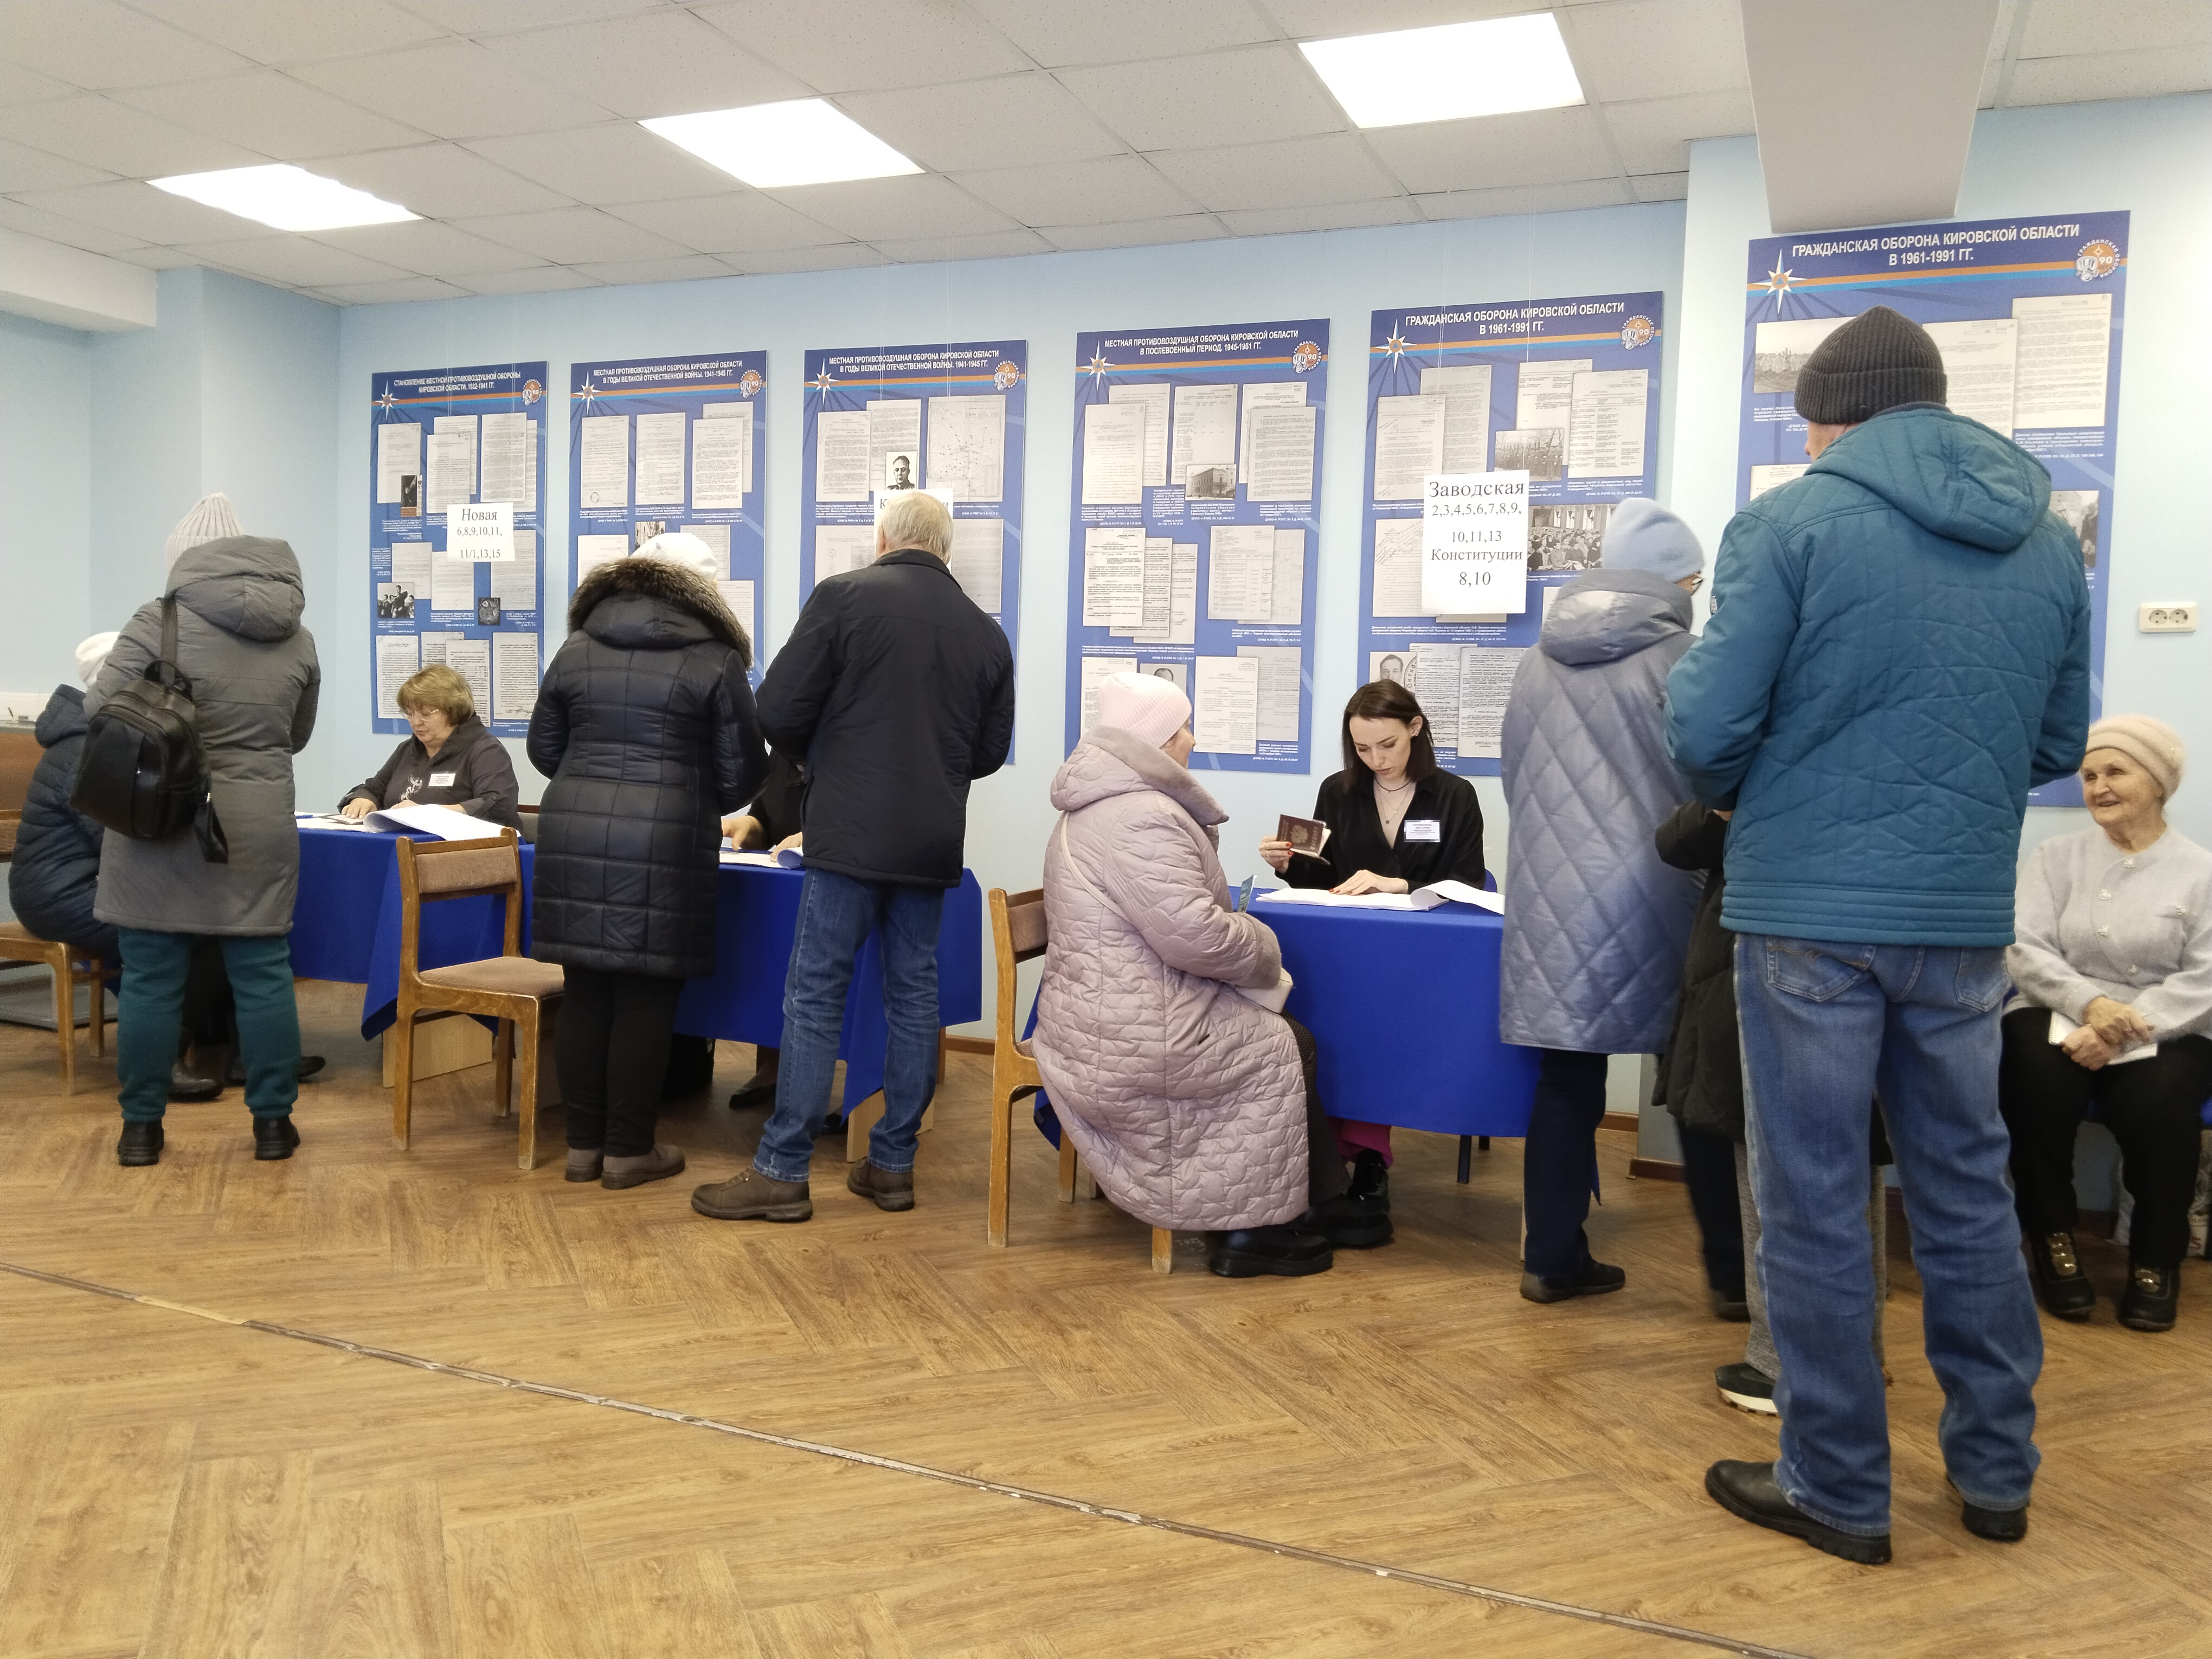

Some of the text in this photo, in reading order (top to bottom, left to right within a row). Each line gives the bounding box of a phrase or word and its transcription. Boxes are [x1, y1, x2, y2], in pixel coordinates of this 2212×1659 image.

[1792, 224, 2079, 256] ГРАЖДАНСКАЯ ОБОРОНА КИРОВСКОЙ ОБЛАСТИ
[1889, 248, 1974, 265] В 1961-1991 ГГ.
[2099, 256, 2113, 265] 90
[1406, 301, 1624, 326] ГРАЖДАНСКАЯ ОБОРОНА КИРОВСКОЙ ОБЛАСТИ
[1480, 321, 1544, 335] В 1961-1991 ГГ.
[1105, 330, 1298, 348] МЕСТНАЯ ПРОТИВОВОЗДУШНАЯ ОБОРОНА КИРОВСКОЙ ОБЛАСТИ
[1146, 344, 1196, 355] ПОСЛЕВОЕННЫЙ
[1224, 342, 1252, 351] 1945-1961
[1253, 341, 1262, 350] ГГ.
[854, 353, 912, 363] ПРОТИВОВОЗДУШНАЯ
[913, 352, 939, 361] ОБОРОНА
[940, 349, 973, 359] КИРОВСКОЙ
[973, 350, 999, 358] ОБЛАСТИ
[615, 365, 666, 376] ПРОТИВОВОЗДУШНАЯ
[691, 360, 719, 370] КИРОВСКОЙ
[719, 360, 742, 368] ОБЛАСТИ
[845, 365, 860, 373] ГОДЫ
[860, 362, 885, 372] ВЕЛИКОЙ
[886, 360, 932, 371] ОТЕЧЕСТВЕННОЙ
[955, 360, 980, 368] 1941-1945
[621, 374, 644, 383] ВЕЛИКОЙ
[644, 371, 684, 381] ОТЕЧЕСТВЕННОЙ
[704, 370, 726, 378] 1941-1945
[1429, 481, 1525, 498] Заводская
[461, 509, 498, 521] Новая
[1432, 502, 1521, 517] 2,3,4,5,6,7,8,9,
[457, 526, 503, 537] 6,8,9,10,11,
[1452, 530, 1502, 544] 10,11,13
[460, 549, 500, 560] 11/1,13,15
[1431, 549, 1523, 563] Конституции
[1459, 571, 1491, 588] 8,10
